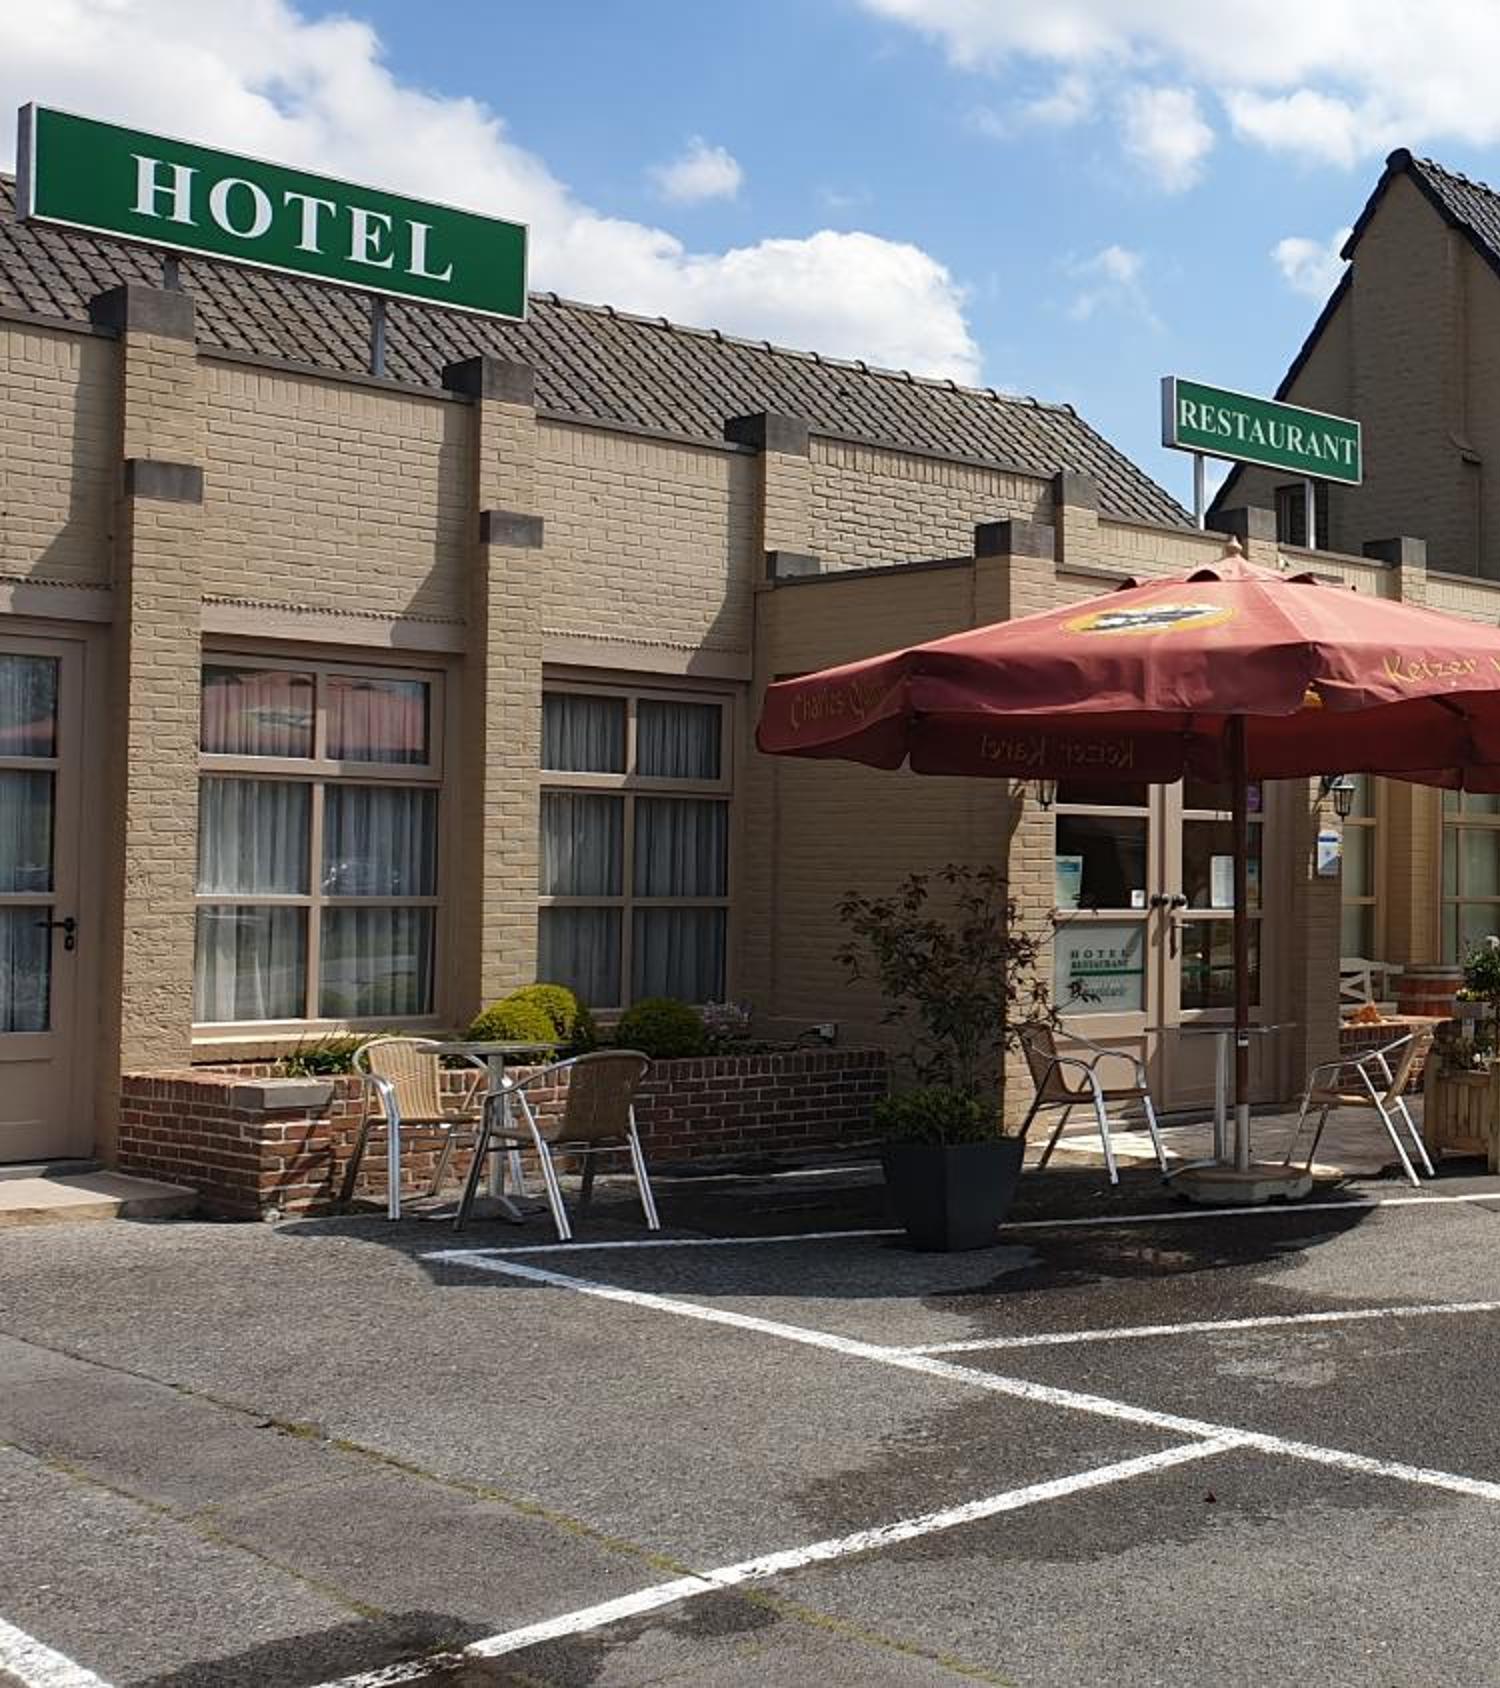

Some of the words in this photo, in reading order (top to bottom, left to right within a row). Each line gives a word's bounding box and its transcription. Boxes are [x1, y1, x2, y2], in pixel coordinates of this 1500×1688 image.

[129, 153, 454, 283] HOTEL
[1179, 398, 1357, 466] RESTAURANT
[1382, 654, 1478, 685] Keizer
